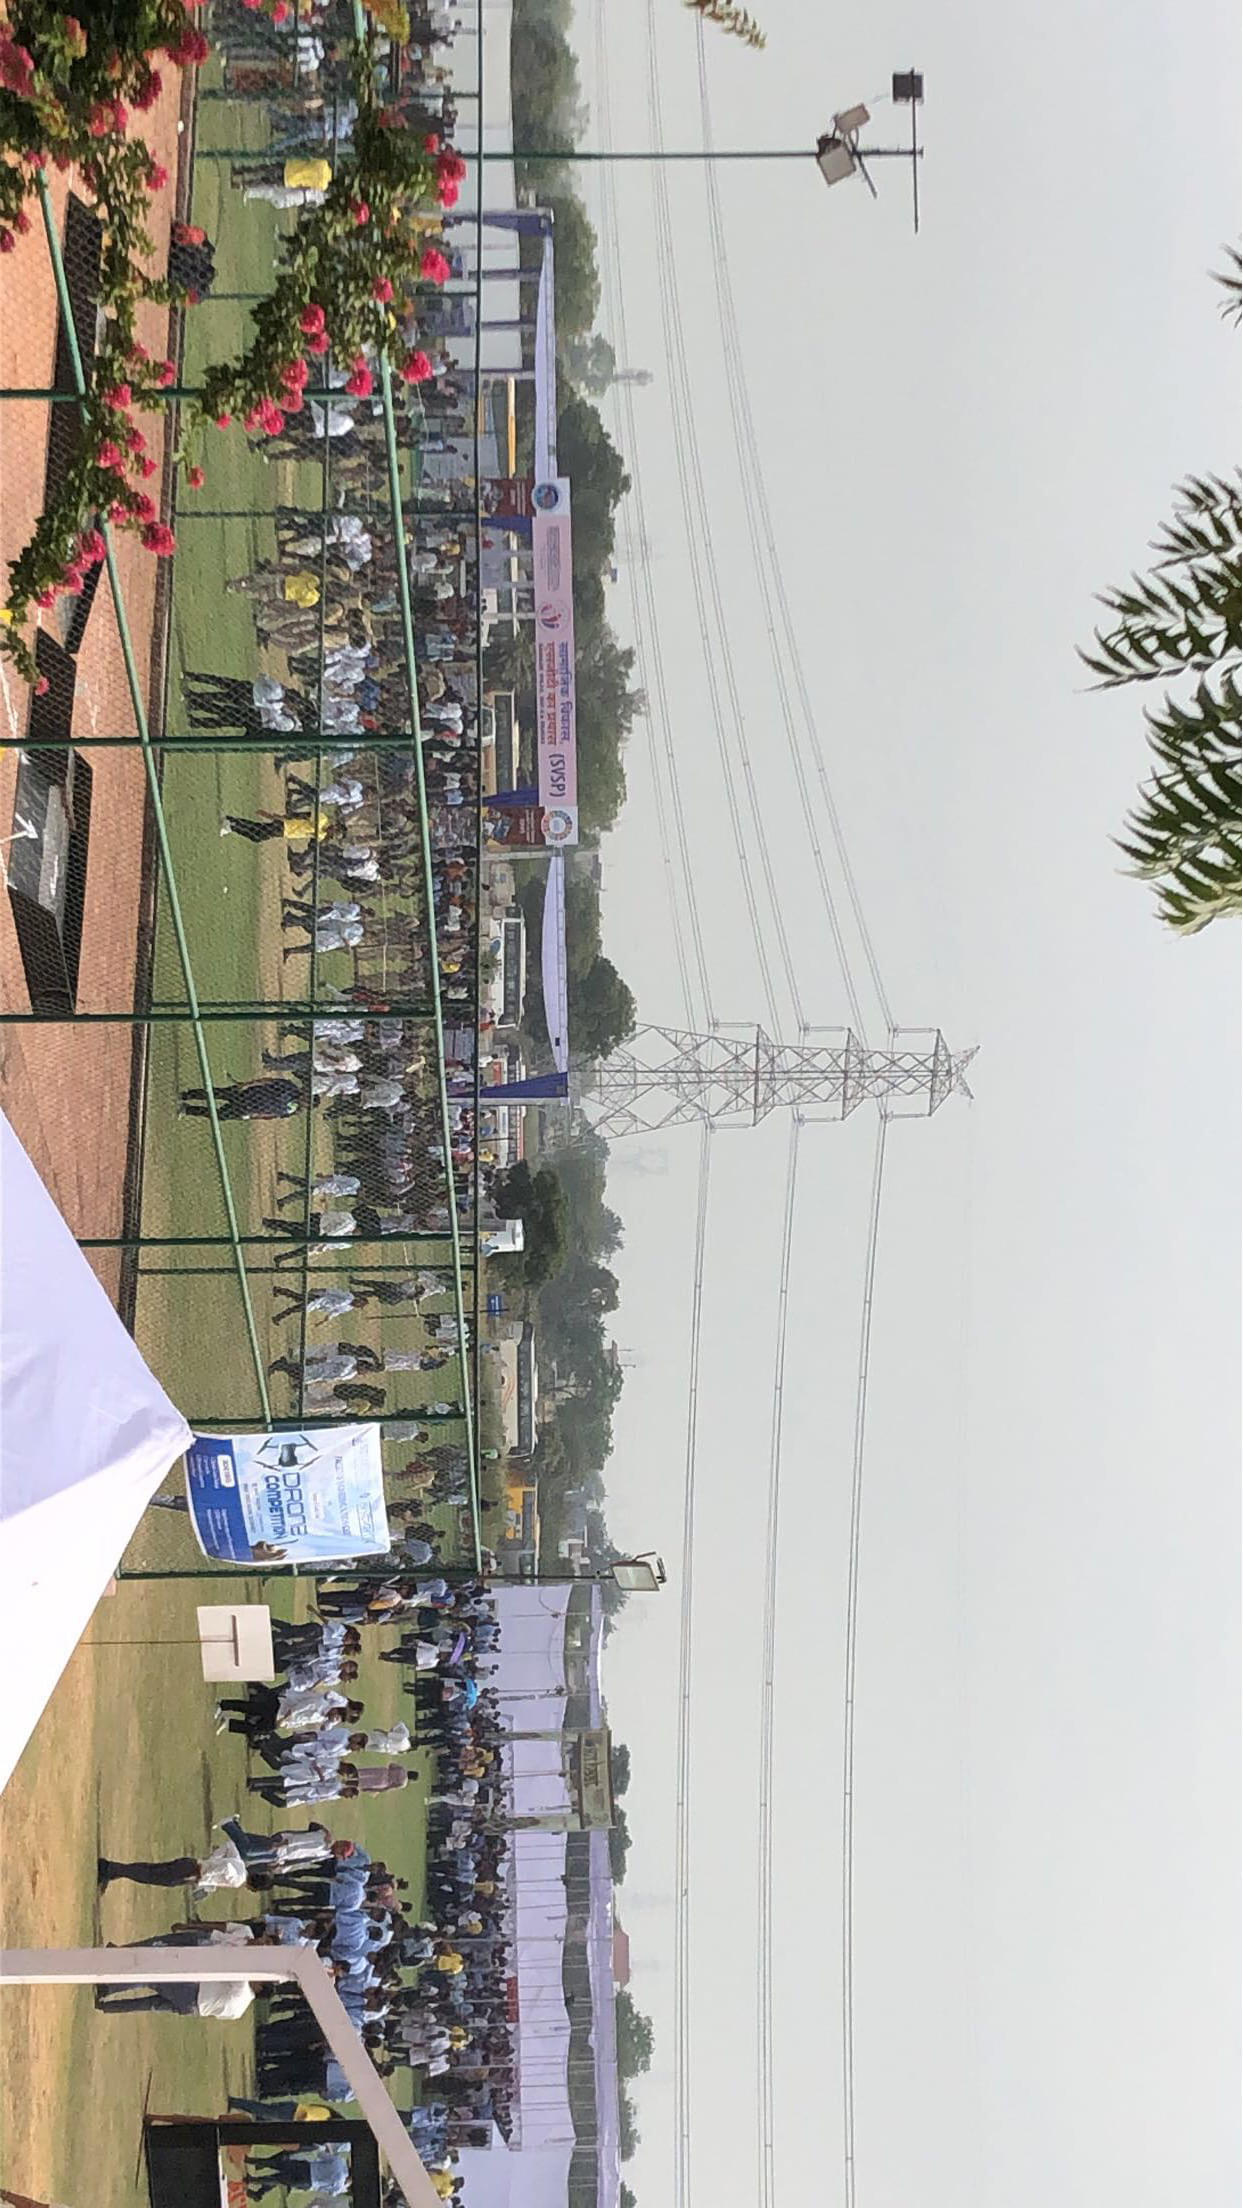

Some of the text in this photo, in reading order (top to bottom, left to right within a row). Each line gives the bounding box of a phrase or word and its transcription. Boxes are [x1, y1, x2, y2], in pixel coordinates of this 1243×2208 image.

[549, 754, 566, 798] (SVSP)
[264, 1475, 288, 1540] COMPETITION
[282, 1472, 307, 1536] DRONE
